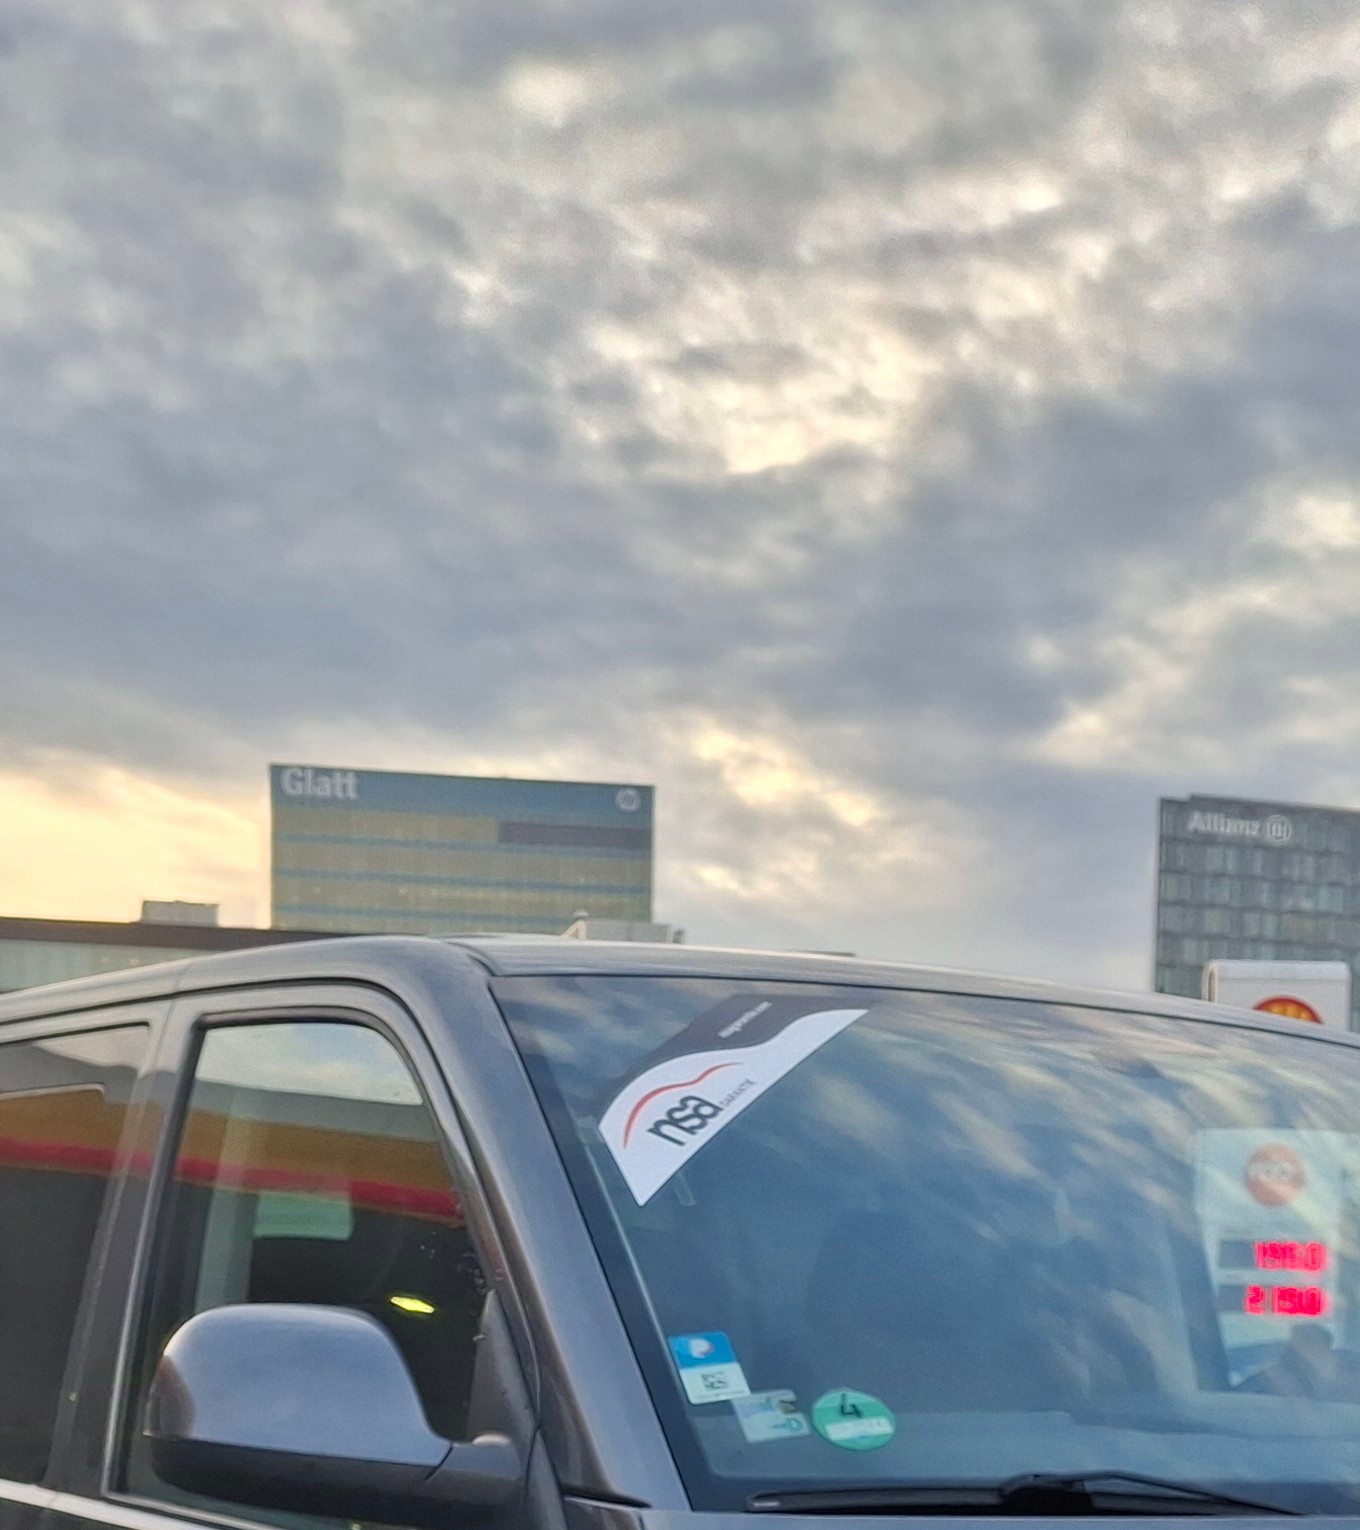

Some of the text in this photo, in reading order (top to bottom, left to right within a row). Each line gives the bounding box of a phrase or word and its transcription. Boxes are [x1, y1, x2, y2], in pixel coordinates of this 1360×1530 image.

[280, 767, 358, 798] Glatt
[1186, 810, 1260, 836] Allianz
[646, 1095, 723, 1147] nsa
[840, 1392, 862, 1418] 4
